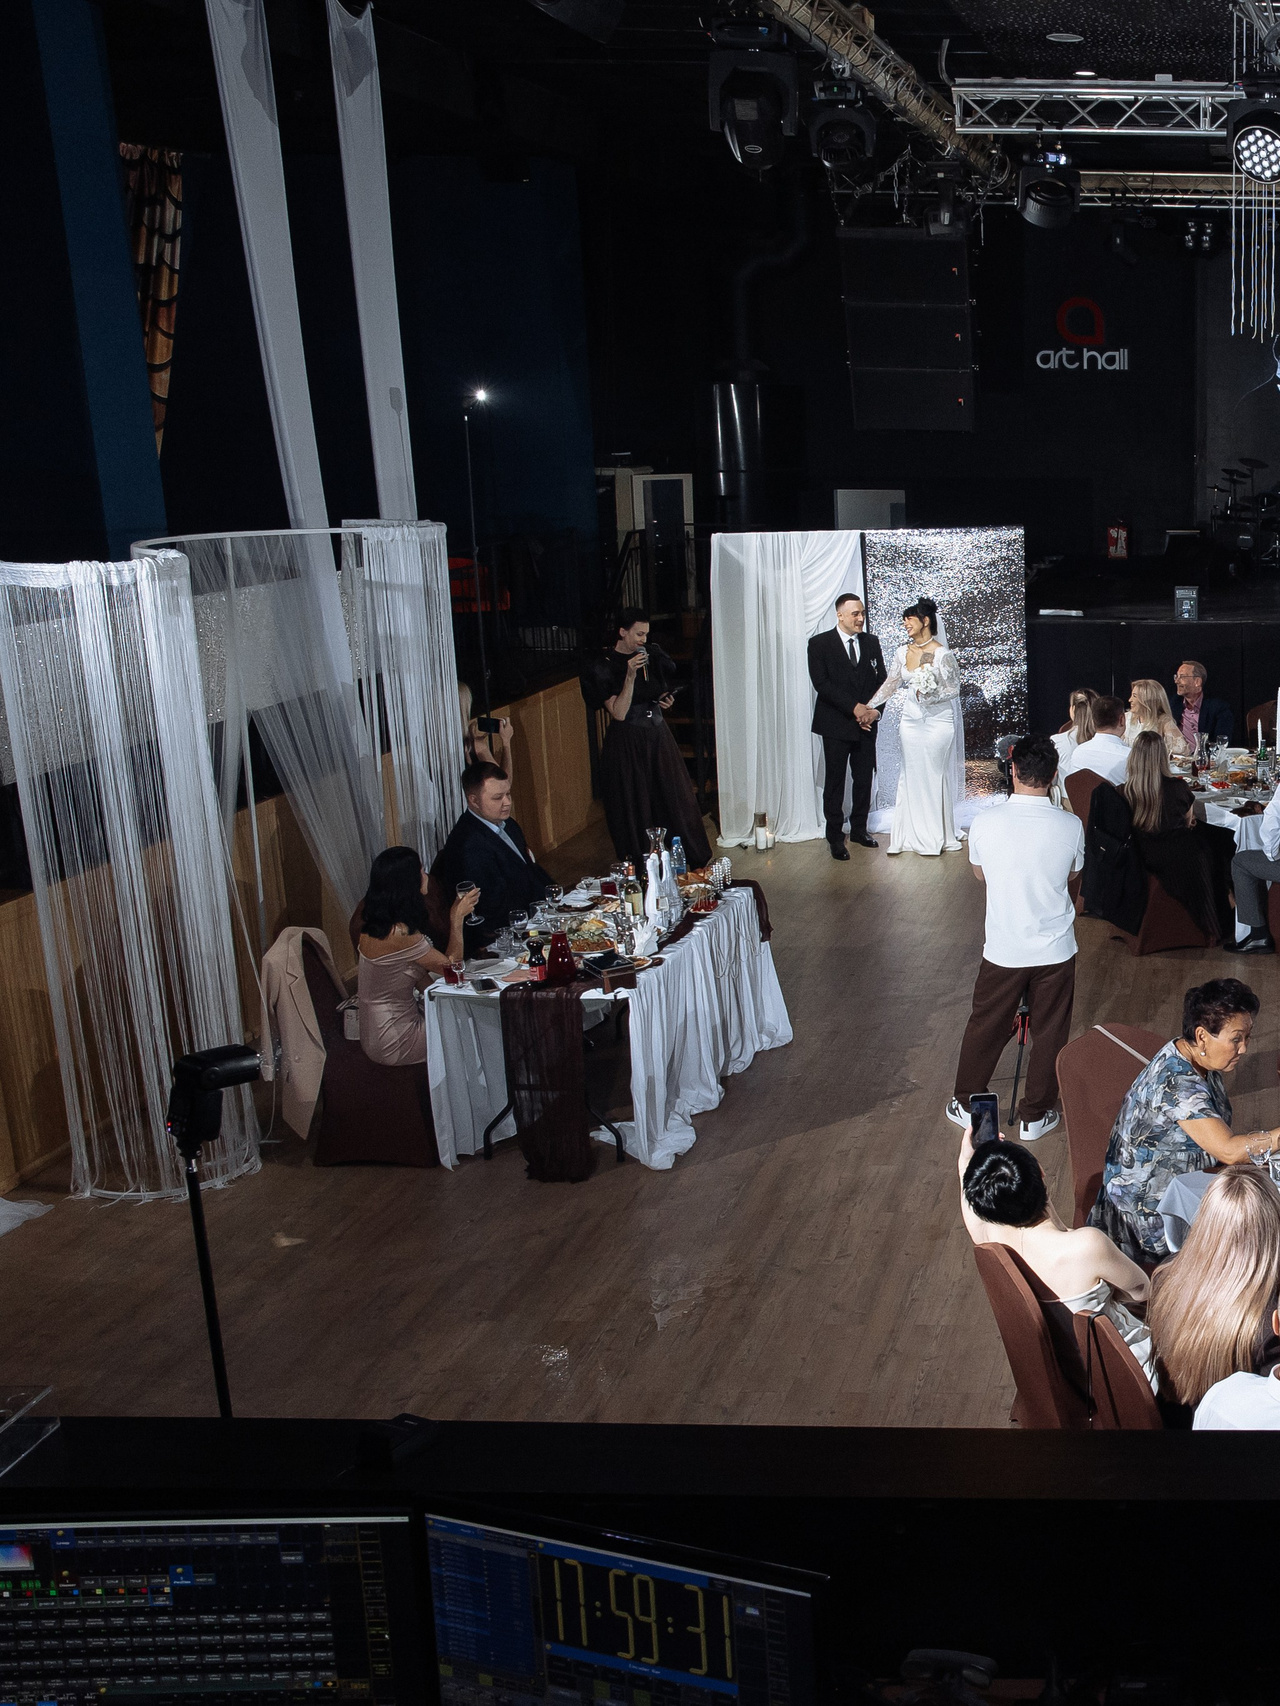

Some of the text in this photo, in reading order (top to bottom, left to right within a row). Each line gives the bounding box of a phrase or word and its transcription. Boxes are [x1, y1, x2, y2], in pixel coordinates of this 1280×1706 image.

[1036, 347, 1129, 370] art hall
[553, 1558, 733, 1678] 17:59:31
